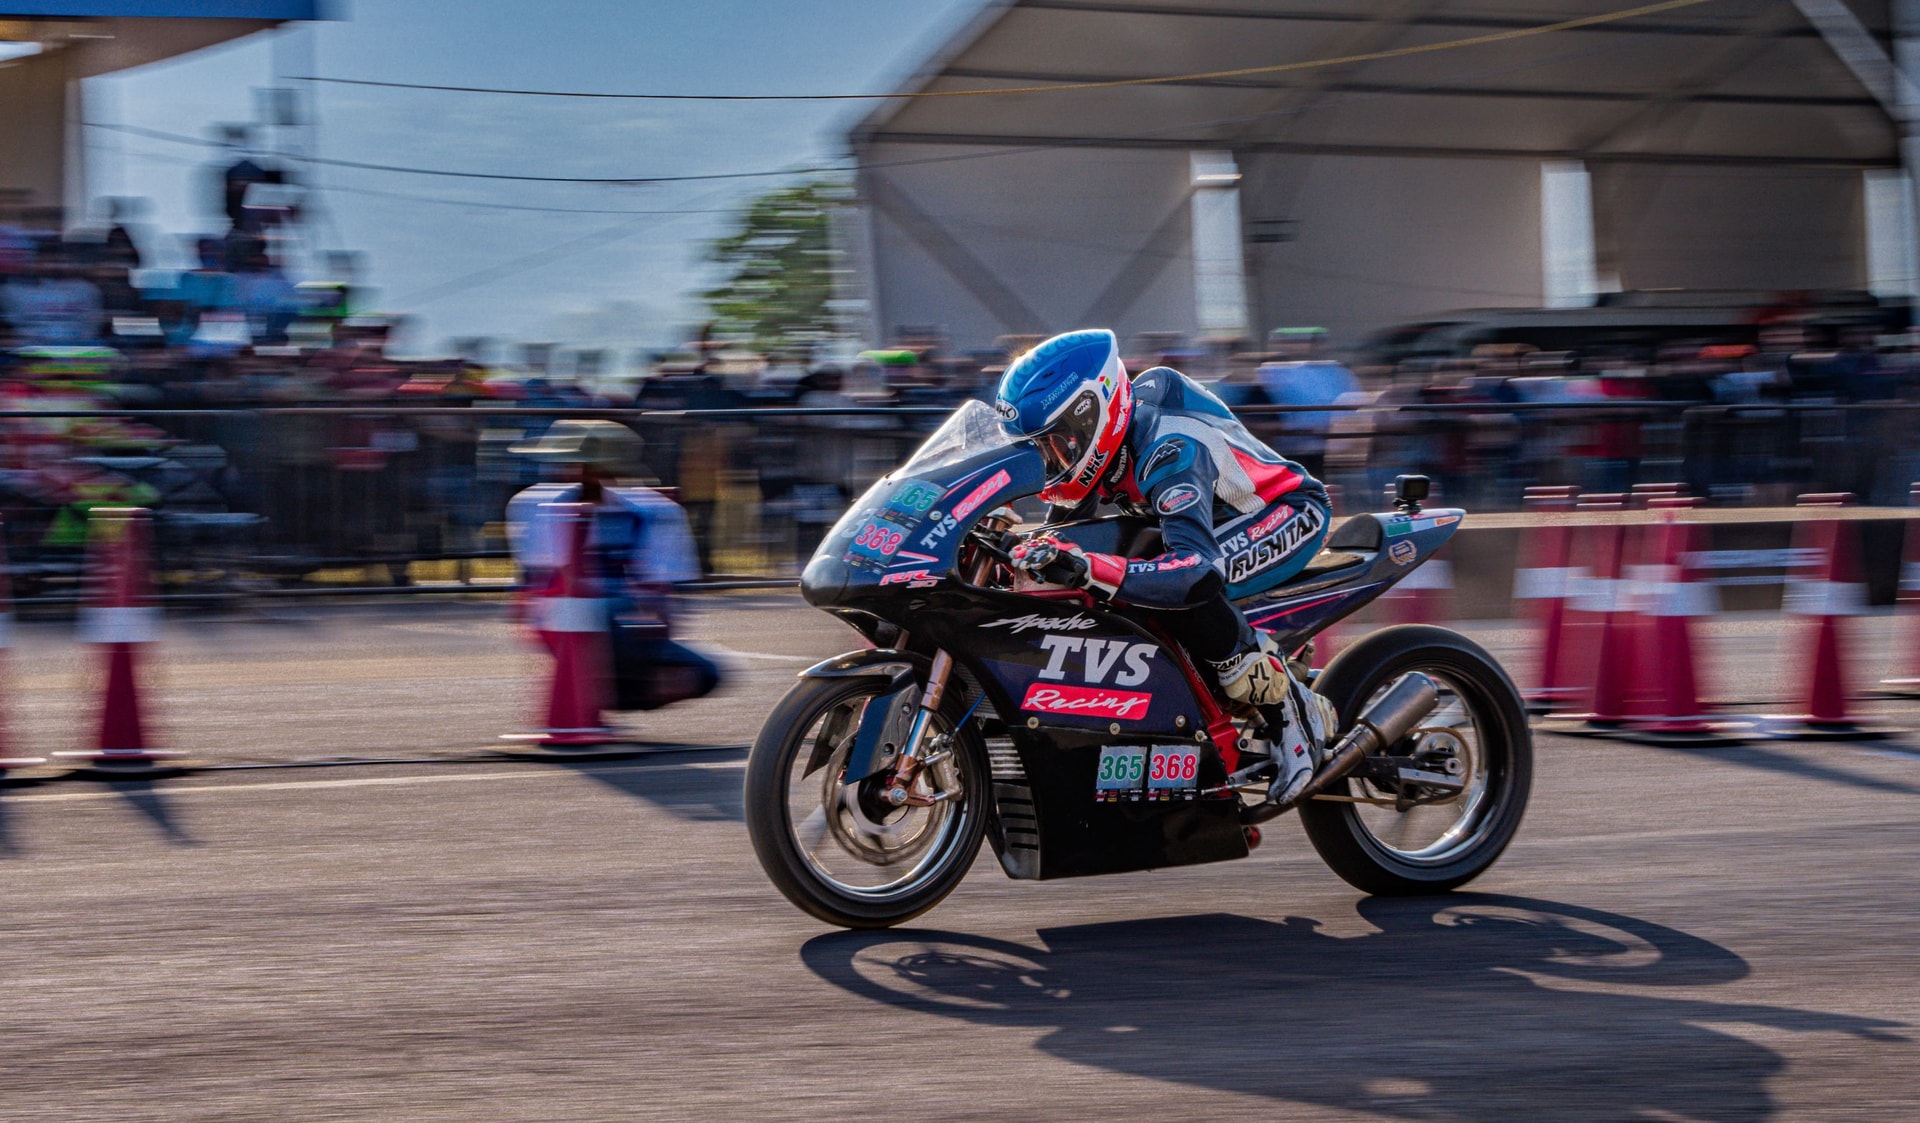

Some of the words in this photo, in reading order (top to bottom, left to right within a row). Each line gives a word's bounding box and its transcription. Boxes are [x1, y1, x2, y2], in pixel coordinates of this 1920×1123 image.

[1078, 447, 1108, 487] NHK
[920, 513, 957, 549] TVS
[955, 470, 1007, 519] Racing
[855, 524, 903, 555] 368
[1219, 531, 1249, 558] TVS
[1251, 505, 1289, 540] Racing
[1128, 563, 1156, 573] TVS
[978, 612, 1099, 634] Apache
[1038, 634, 1159, 687] TVS
[1024, 689, 1148, 715] Racing
[1100, 754, 1143, 781] 365
[1151, 754, 1197, 781] 368
